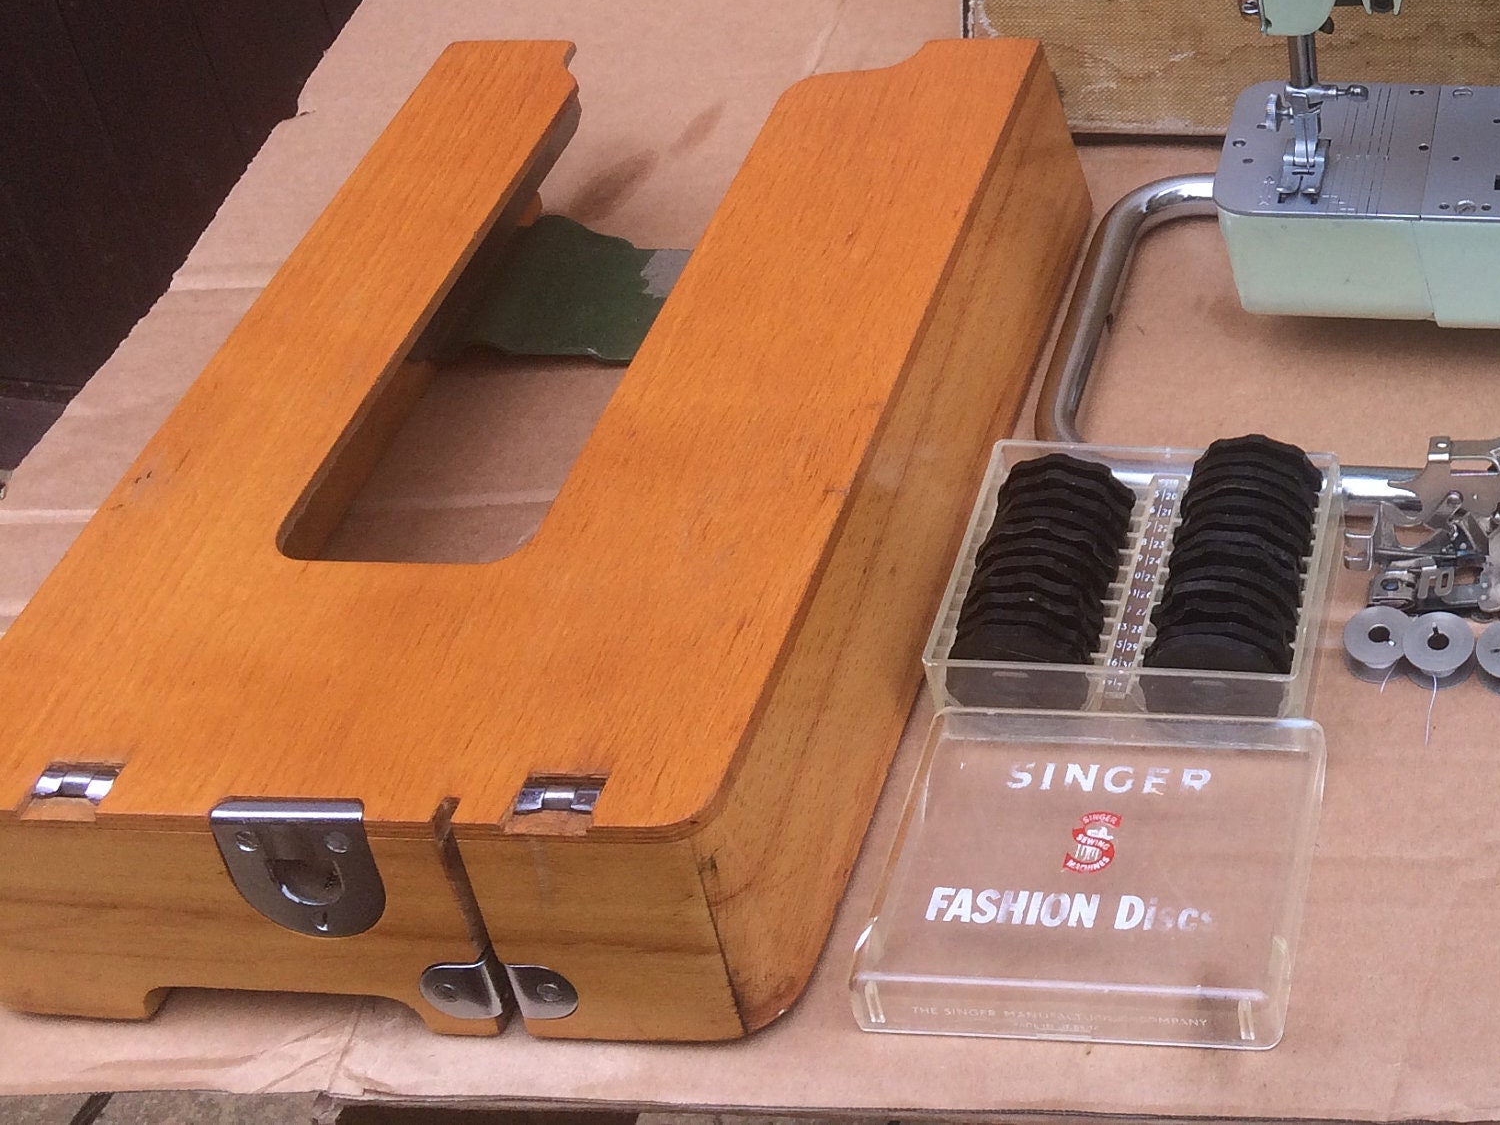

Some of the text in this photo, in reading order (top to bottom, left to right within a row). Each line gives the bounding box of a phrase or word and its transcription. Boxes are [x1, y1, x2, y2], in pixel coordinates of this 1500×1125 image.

[1007, 762, 1212, 795] SINGER
[1082, 813, 1118, 825] SINGER
[1075, 833, 1110, 851] SEWING
[1066, 856, 1110, 872] MACHINES
[925, 886, 1100, 928] FASHION
